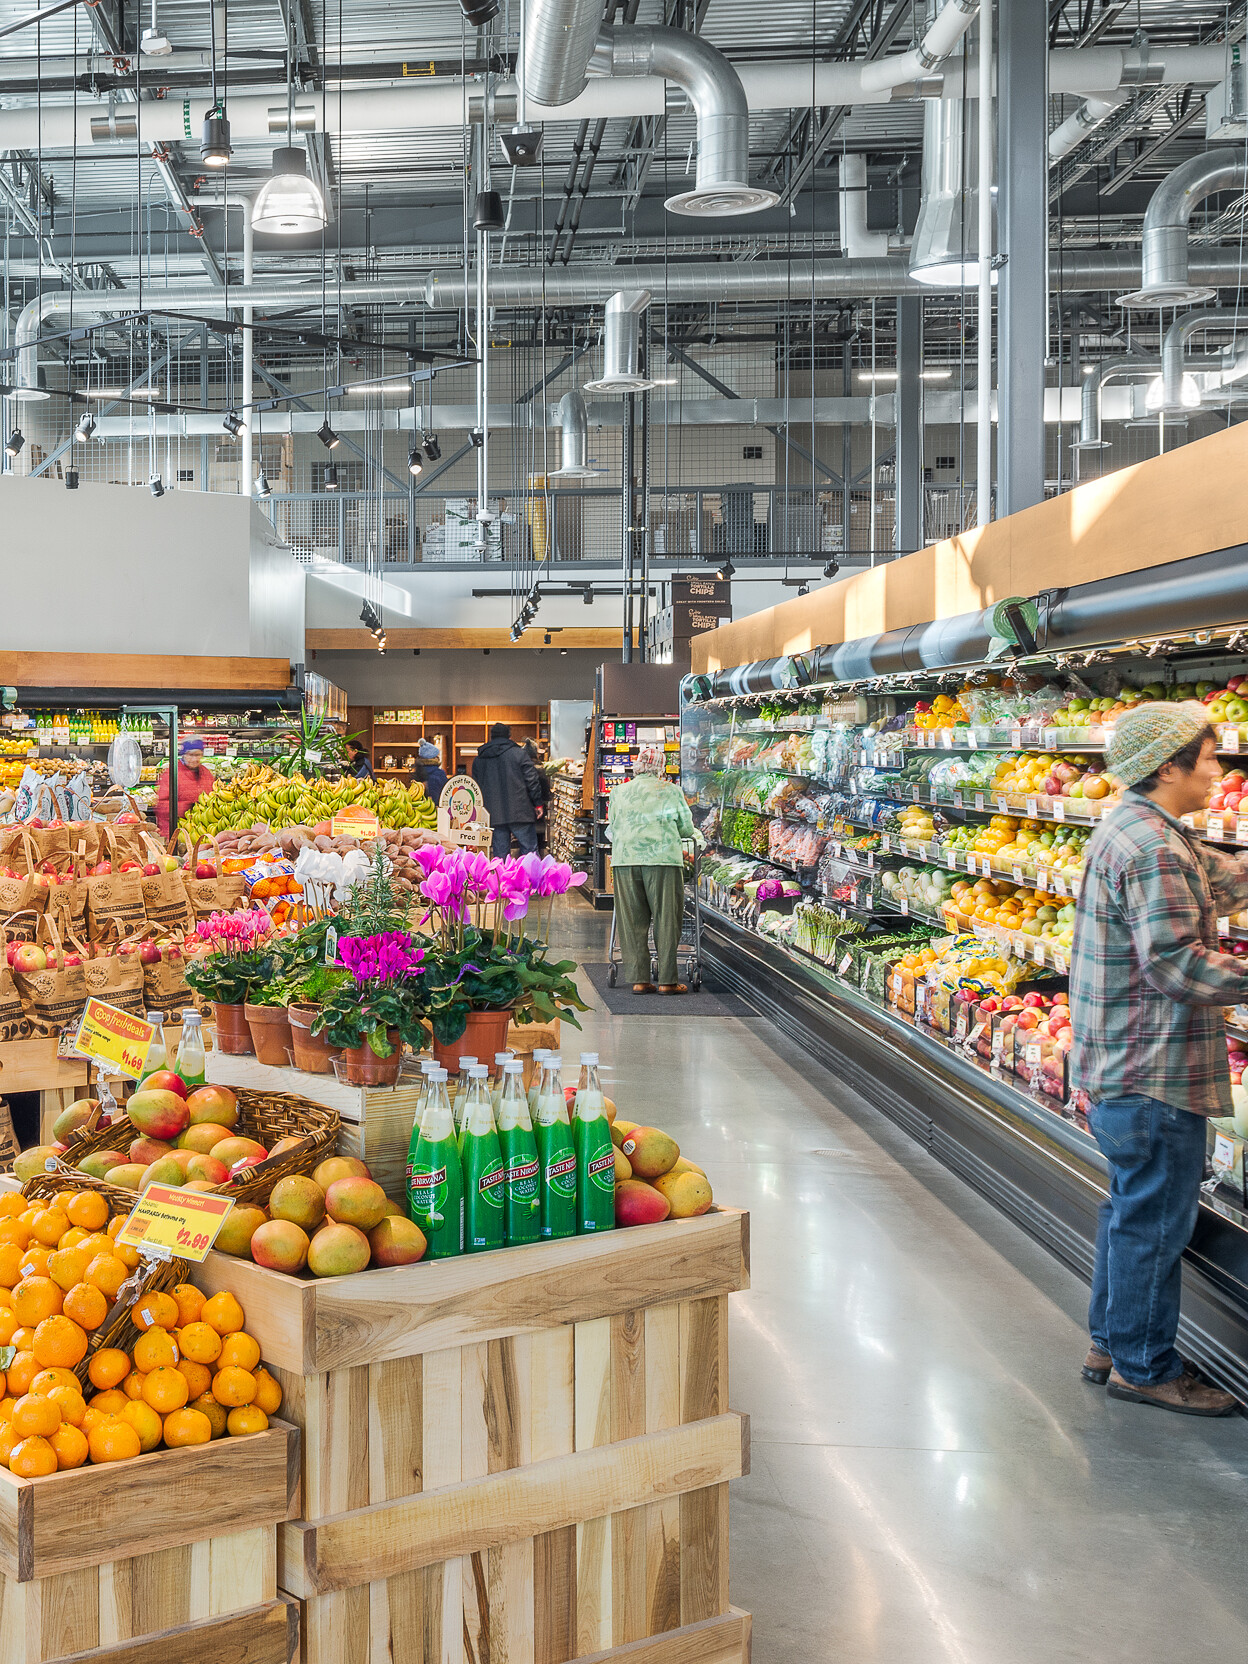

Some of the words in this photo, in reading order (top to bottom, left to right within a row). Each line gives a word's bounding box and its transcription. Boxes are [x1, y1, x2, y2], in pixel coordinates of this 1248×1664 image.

[122, 1049, 143, 1070] $1.69
[549, 1166, 565, 1175] TASTE
[592, 1158, 608, 1171] TASTE
[416, 1173, 444, 1185] NIRVANA
[482, 1173, 498, 1187] TASTE
[176, 1227, 210, 1250] $2.99
